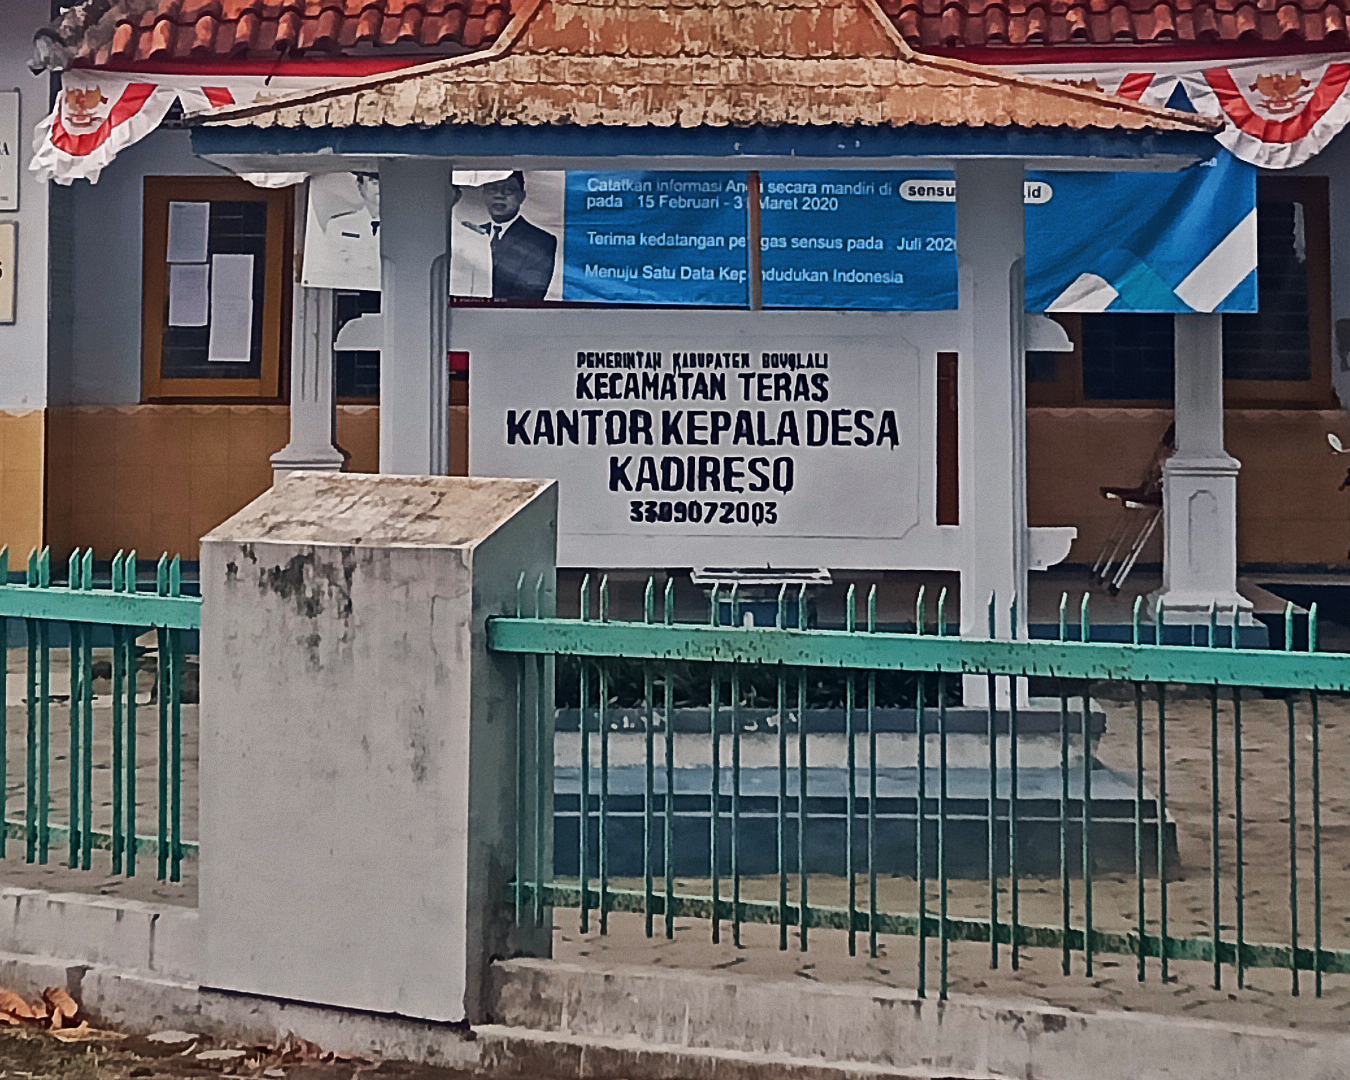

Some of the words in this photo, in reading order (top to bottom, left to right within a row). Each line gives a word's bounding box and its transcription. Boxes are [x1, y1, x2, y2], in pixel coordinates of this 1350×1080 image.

[587, 178, 652, 193] Catatkan
[657, 178, 722, 193] informasi
[767, 182, 817, 194] secara
[821, 181, 875, 196] mandiri
[879, 181, 893, 196] di
[587, 195, 623, 210] pada
[637, 195, 655, 208] 15
[659, 195, 719, 209] Februari
[801, 197, 838, 211] 2020
[587, 231, 636, 246] Terima
[639, 233, 725, 251] kedatangan
[728, 236, 787, 251] pegas
[791, 237, 843, 250] sensus
[847, 237, 884, 252] pada
[897, 237, 922, 251] Juli
[925, 238, 957, 252] 202
[585, 264, 638, 282] Menuju
[642, 266, 676, 280] Satu
[680, 266, 715, 281] Data
[833, 269, 903, 284] Indonesia
[576, 351, 662, 370] PEMERINTAH
[672, 352, 750, 370] KABUPATEN
[761, 352, 829, 370] BOYOLALI
[576, 372, 726, 401] KECAMATAN
[738, 372, 829, 402] TERAS
[506, 409, 653, 446] KANTOR
[661, 409, 799, 446] KEPALA
[805, 409, 900, 449] DESA
[609, 455, 794, 494] KADIRESO
